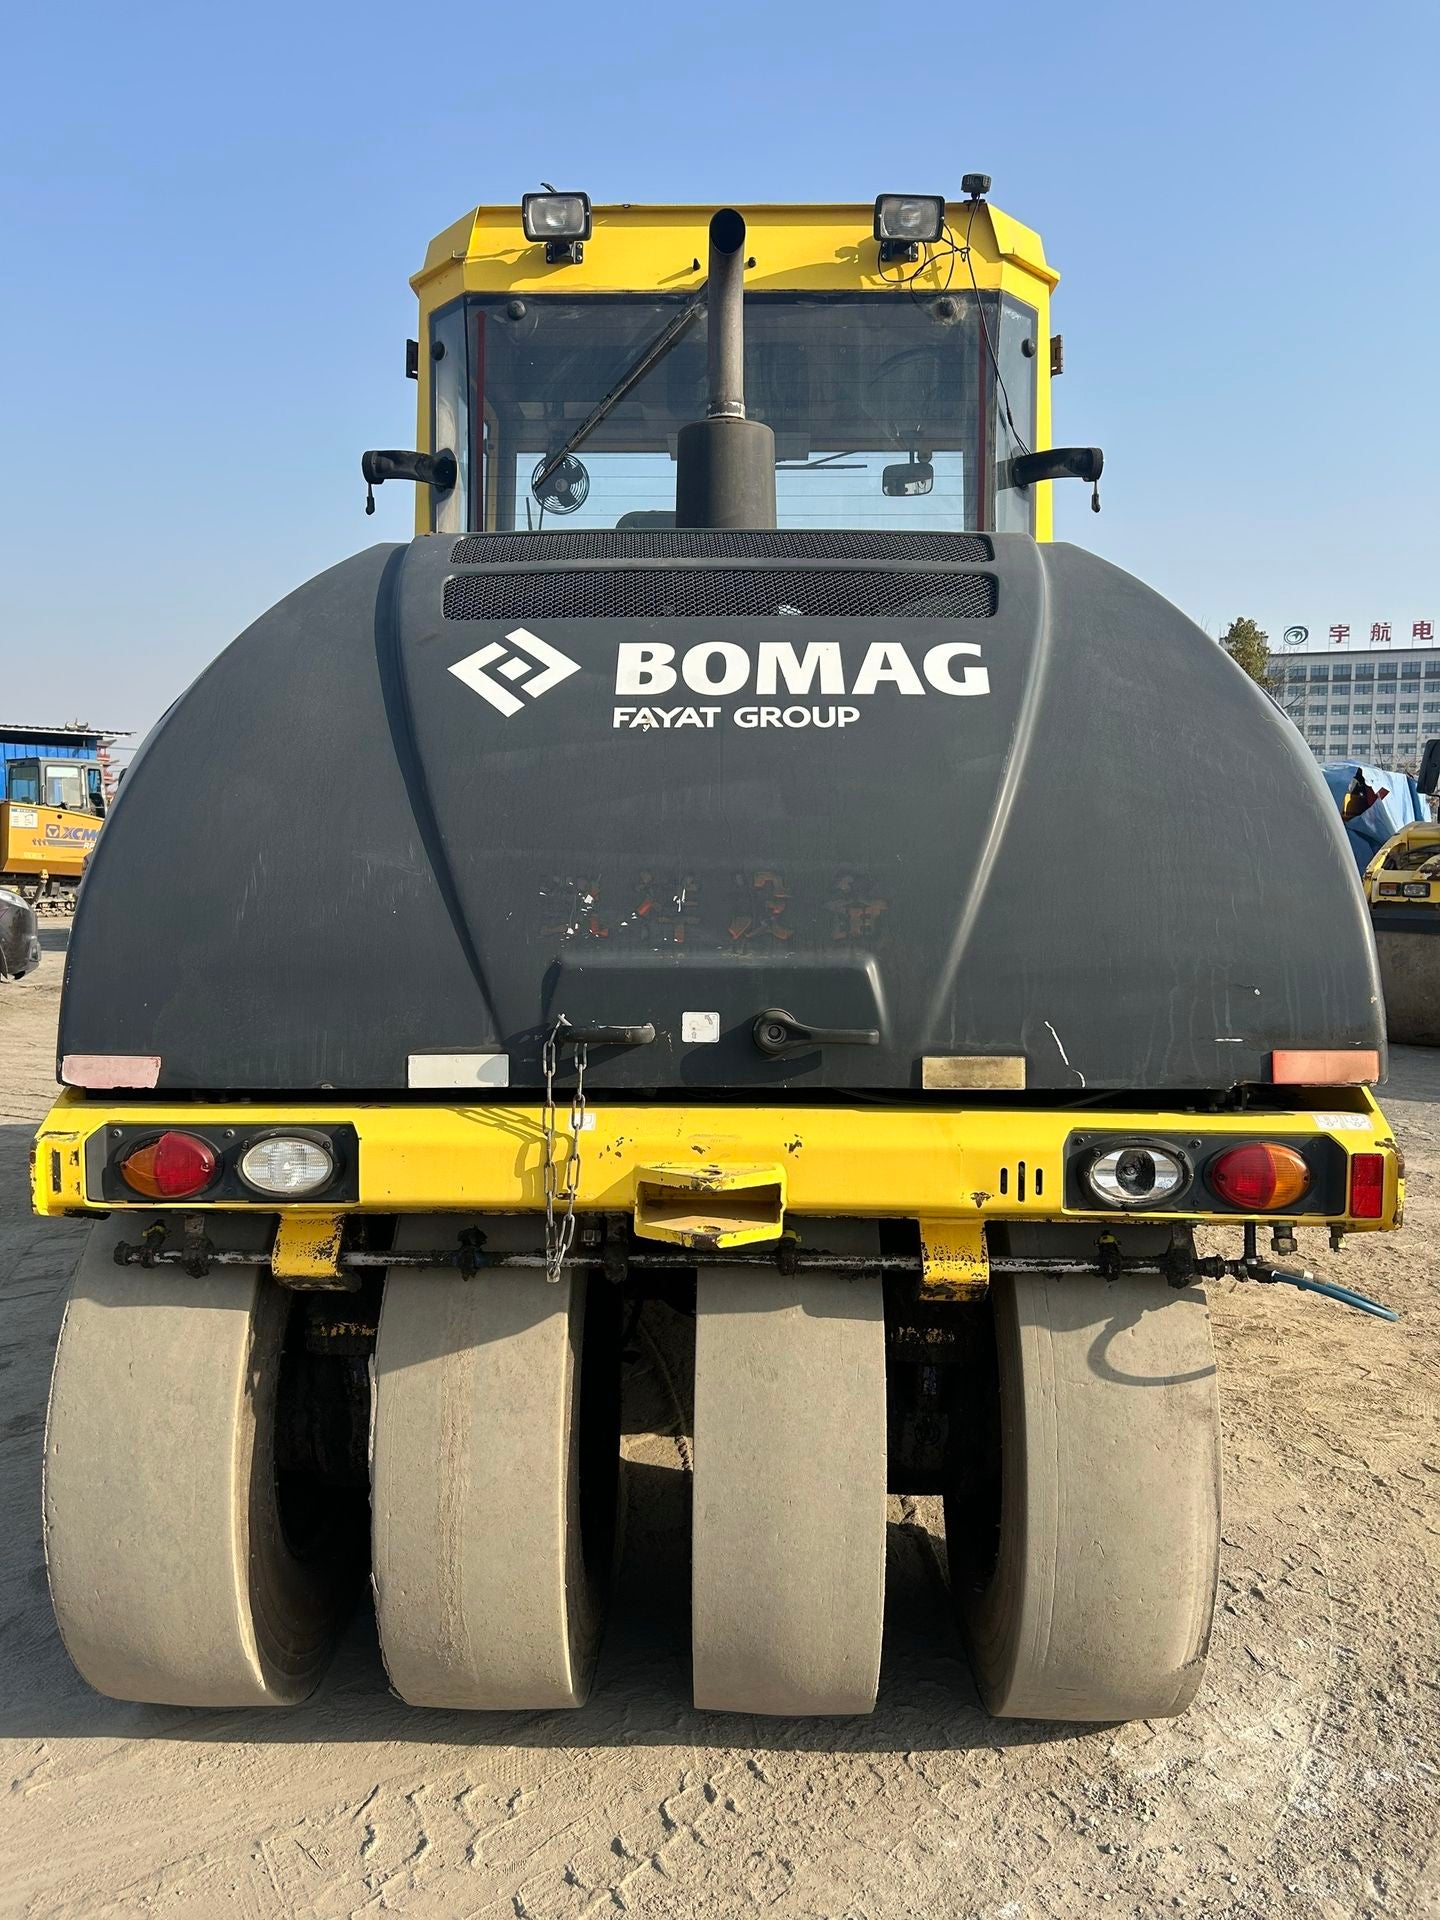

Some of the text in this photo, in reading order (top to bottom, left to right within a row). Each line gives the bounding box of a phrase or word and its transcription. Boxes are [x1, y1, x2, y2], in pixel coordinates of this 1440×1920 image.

[1330, 621, 1433, 643] 宇航电
[615, 642, 991, 696] BOMAG
[613, 705, 860, 729] FAYAT GROUP
[62, 826, 98, 841] XCM
